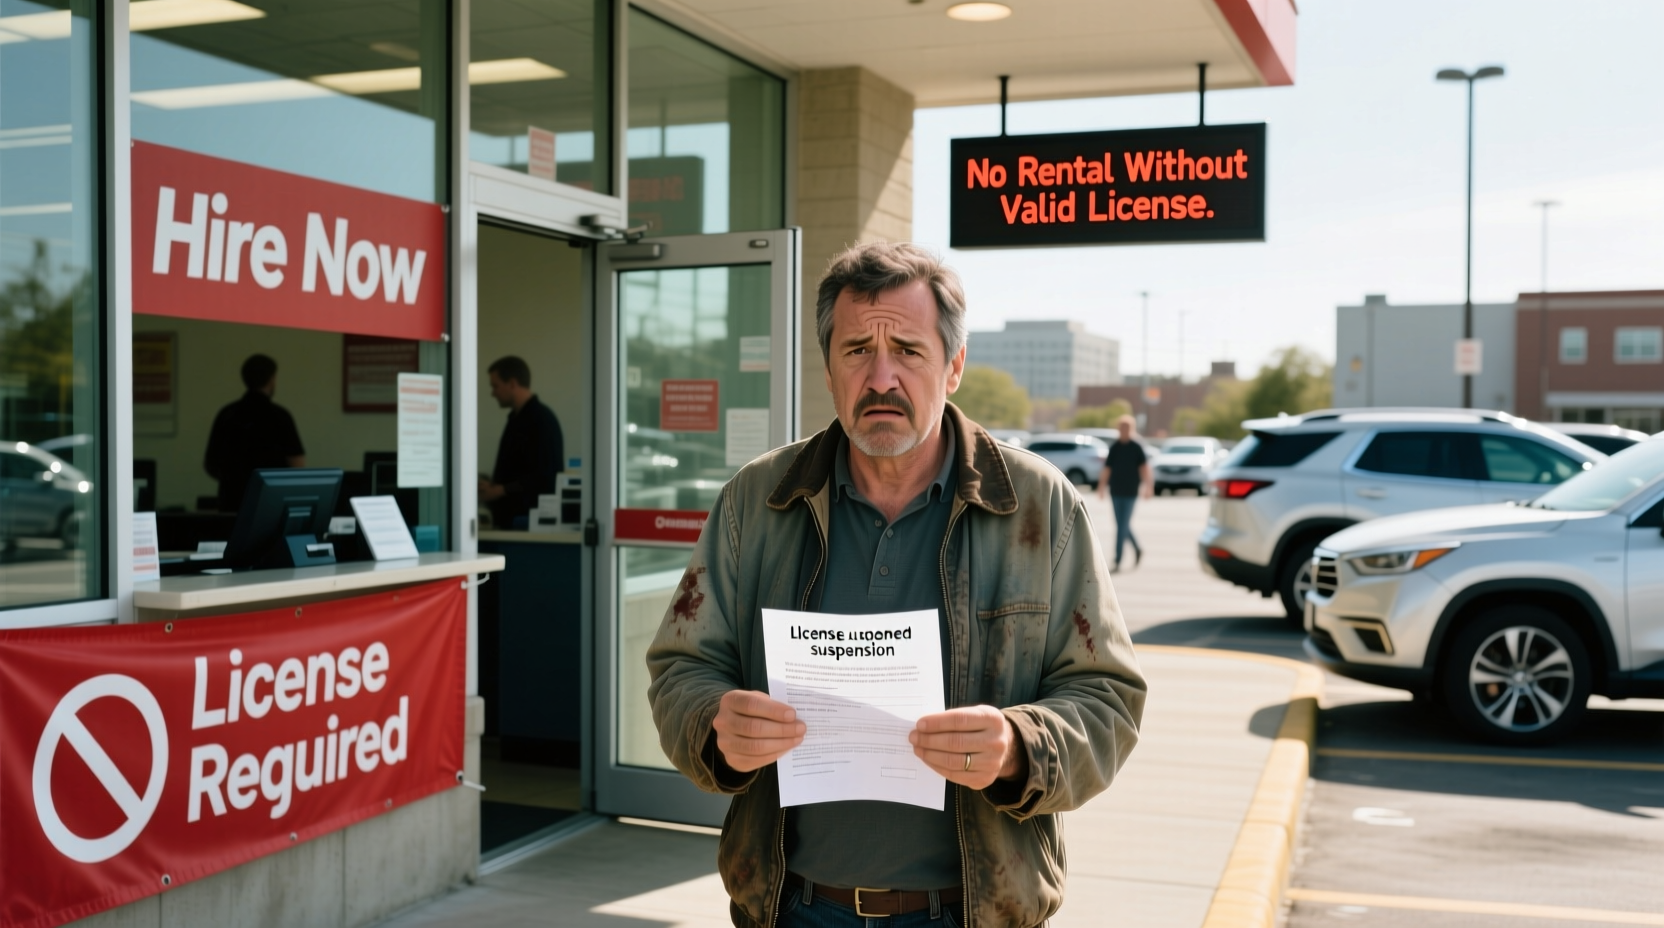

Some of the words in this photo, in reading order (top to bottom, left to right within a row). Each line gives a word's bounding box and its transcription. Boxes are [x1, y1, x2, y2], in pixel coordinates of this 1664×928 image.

[967, 157, 1008, 189] No
[1018, 151, 1115, 188] Rental
[1123, 148, 1249, 183] Without
[1000, 190, 1077, 225] Valid
[1088, 189, 1216, 223] License.
[152, 186, 288, 289] Hire
[301, 212, 427, 305] Now
[810, 641, 895, 661] suspension
[191, 641, 391, 730] License
